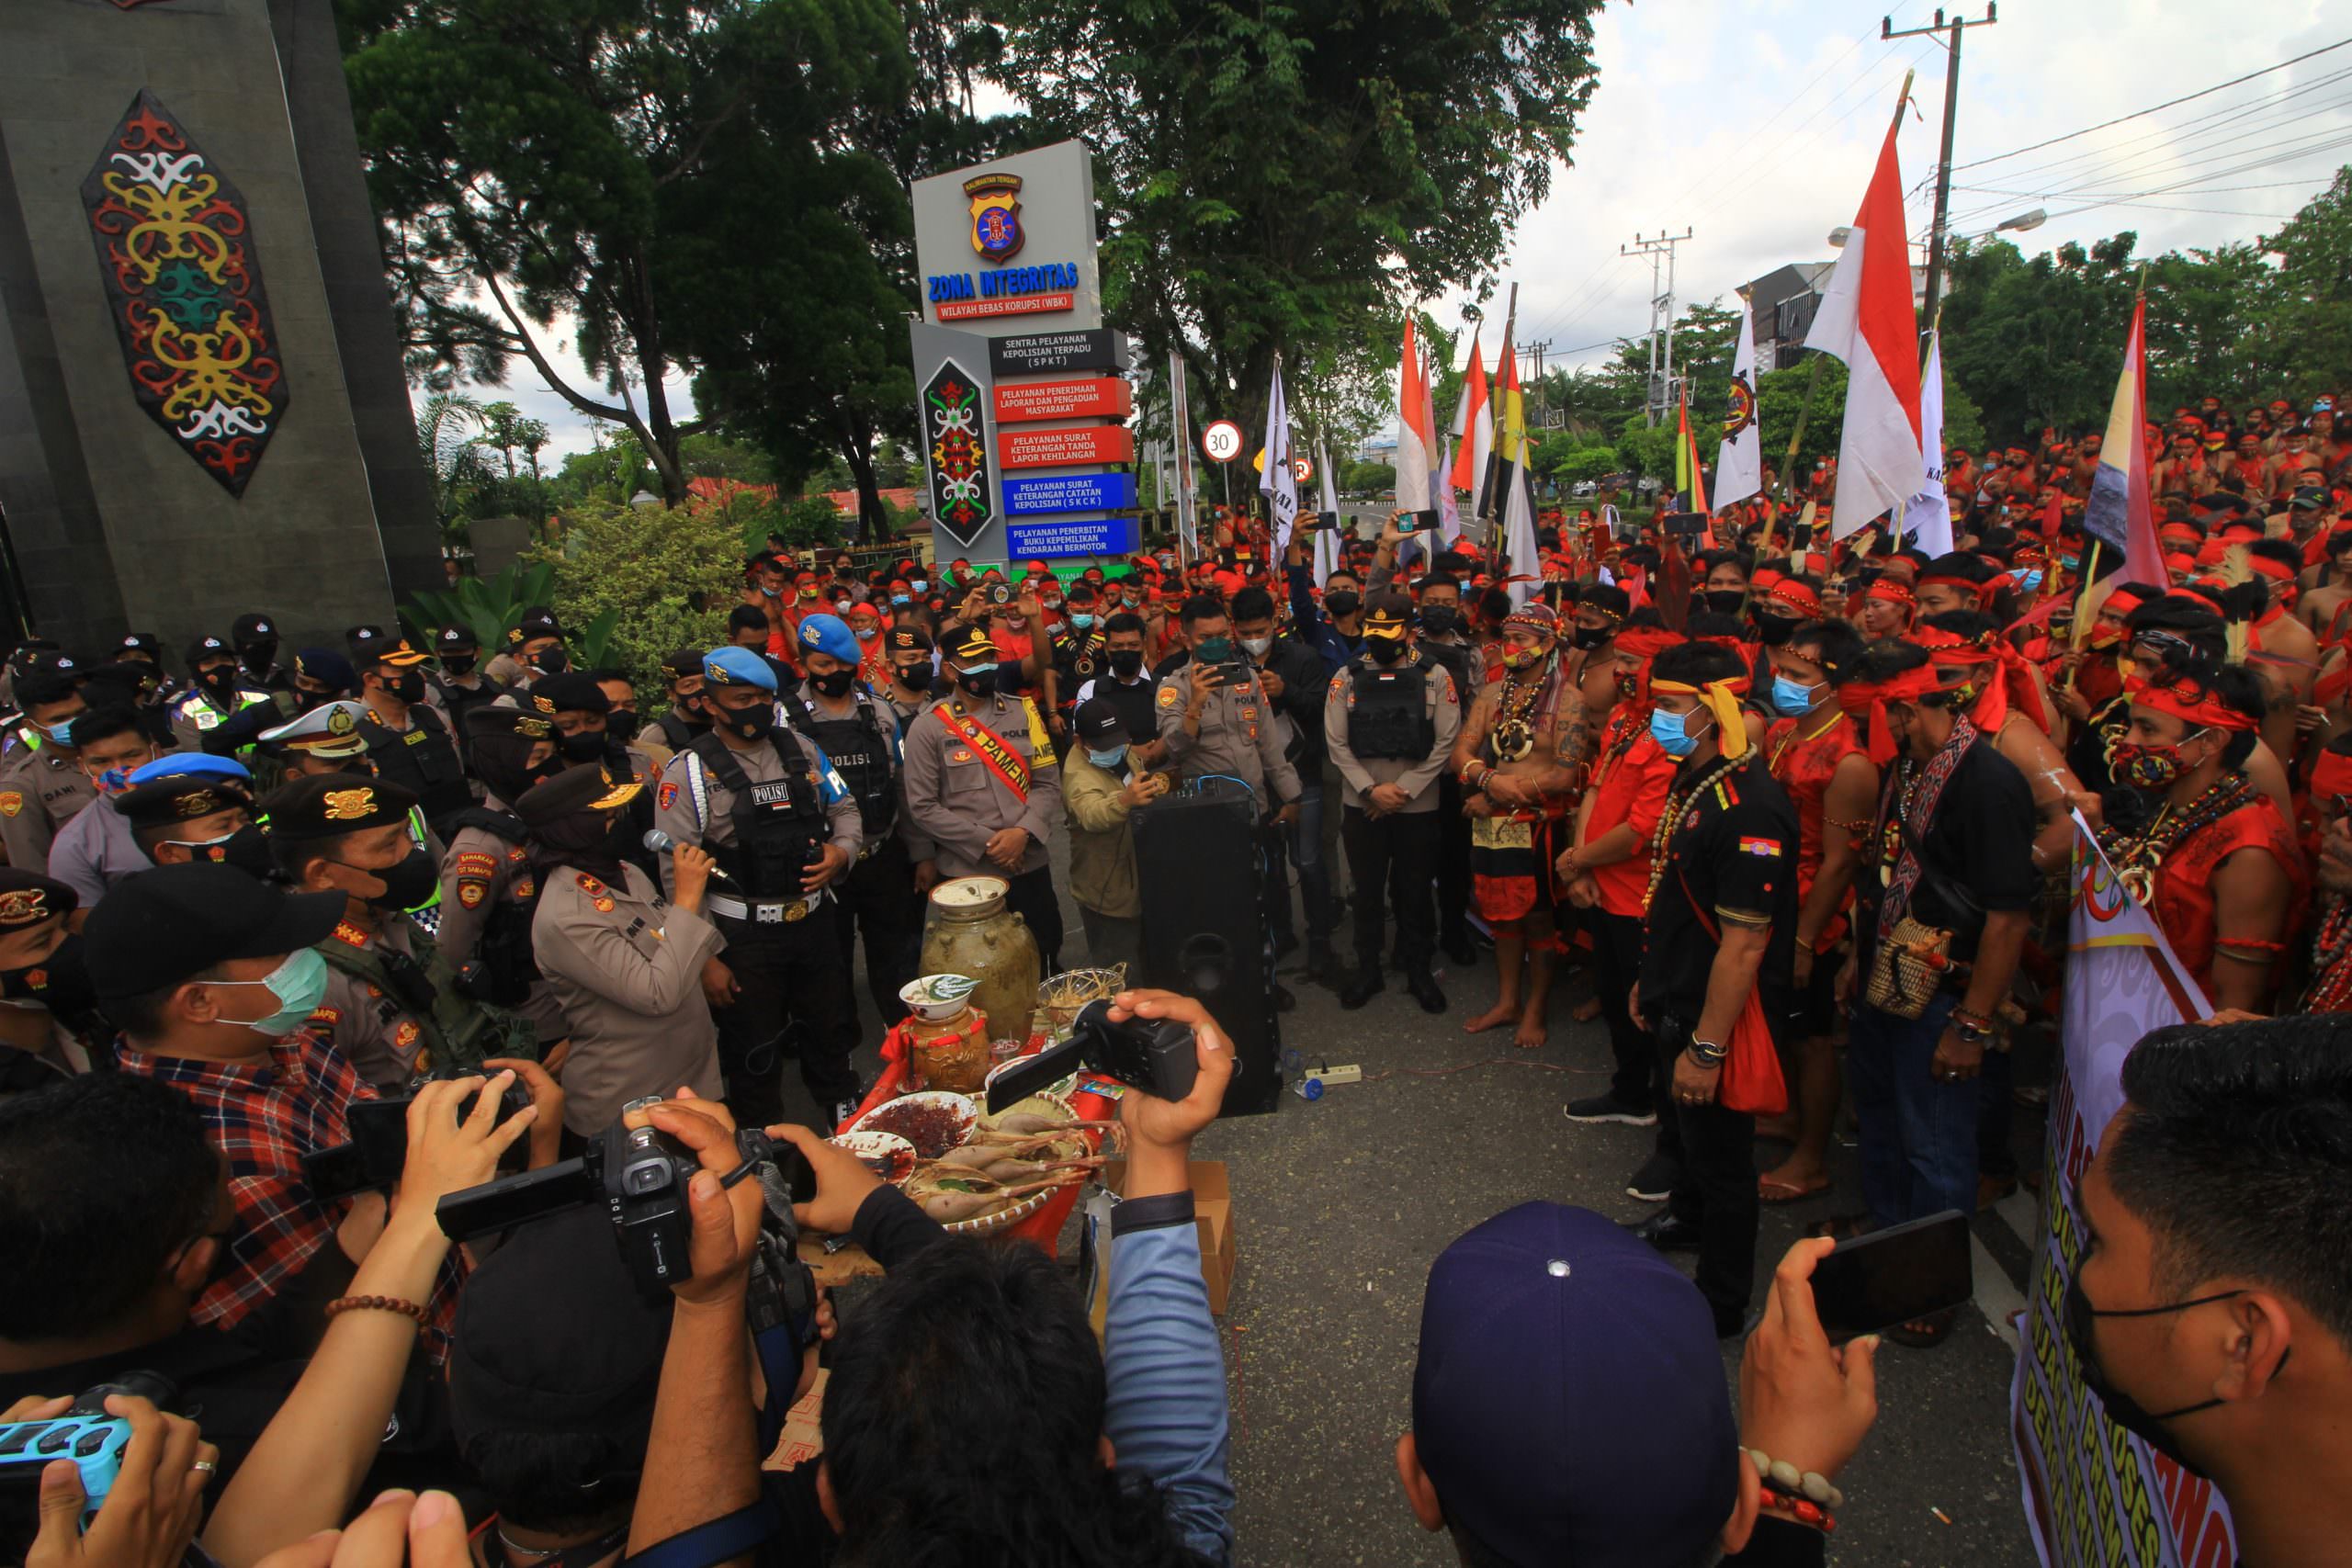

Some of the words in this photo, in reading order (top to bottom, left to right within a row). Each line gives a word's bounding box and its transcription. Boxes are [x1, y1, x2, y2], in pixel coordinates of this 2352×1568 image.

[928, 273, 975, 301] ZONA
[979, 262, 1079, 297] INTEGRITAS
[941, 304, 978, 317] WILAYAH
[978, 302, 1003, 314] BEBAS
[1005, 299, 1040, 311] KORUPSI
[1042, 296, 1068, 310] (WBK)
[1005, 337, 1037, 348] SENTRA
[1038, 334, 1087, 346] PELAYANAN
[1002, 347, 1052, 358] KEPOLISIAN
[1054, 344, 1091, 354] TERPADU
[1002, 389, 1046, 399] PELAYANAN
[1046, 385, 1096, 396] PENERIMAAN
[1000, 398, 1035, 408] LAPORAN
[1036, 396, 1052, 406] DAN
[1053, 393, 1099, 404] PENGADUAN
[1025, 404, 1075, 415] MASYARAKAT
[1013, 434, 1061, 446] PELAYANAN
[1064, 433, 1092, 442] SURAT
[1209, 434, 1229, 451] 30
[1011, 444, 1065, 455] KETERANGAN
[1067, 442, 1096, 451] TANDA
[1012, 454, 1039, 463] LAPOR
[1041, 450, 1096, 462] KEHILANGAN
[1020, 482, 1065, 492] PELAYANAN
[1067, 479, 1092, 490] SURAT
[1013, 491, 1065, 501] KETERANGAN
[1066, 489, 1102, 499] CATATAN
[1014, 500, 1061, 510] KEPOLISIAN
[1013, 528, 1057, 538] PELAYANAN
[1059, 525, 1108, 536] PENERBITAN
[1023, 537, 1046, 546] BUKU
[1046, 535, 1099, 545] KEPEMILIKAN
[1017, 545, 1063, 554] KENDARAAN
[1065, 542, 1107, 552] BERMOTOR
[754, 784, 786, 803] POLISI
